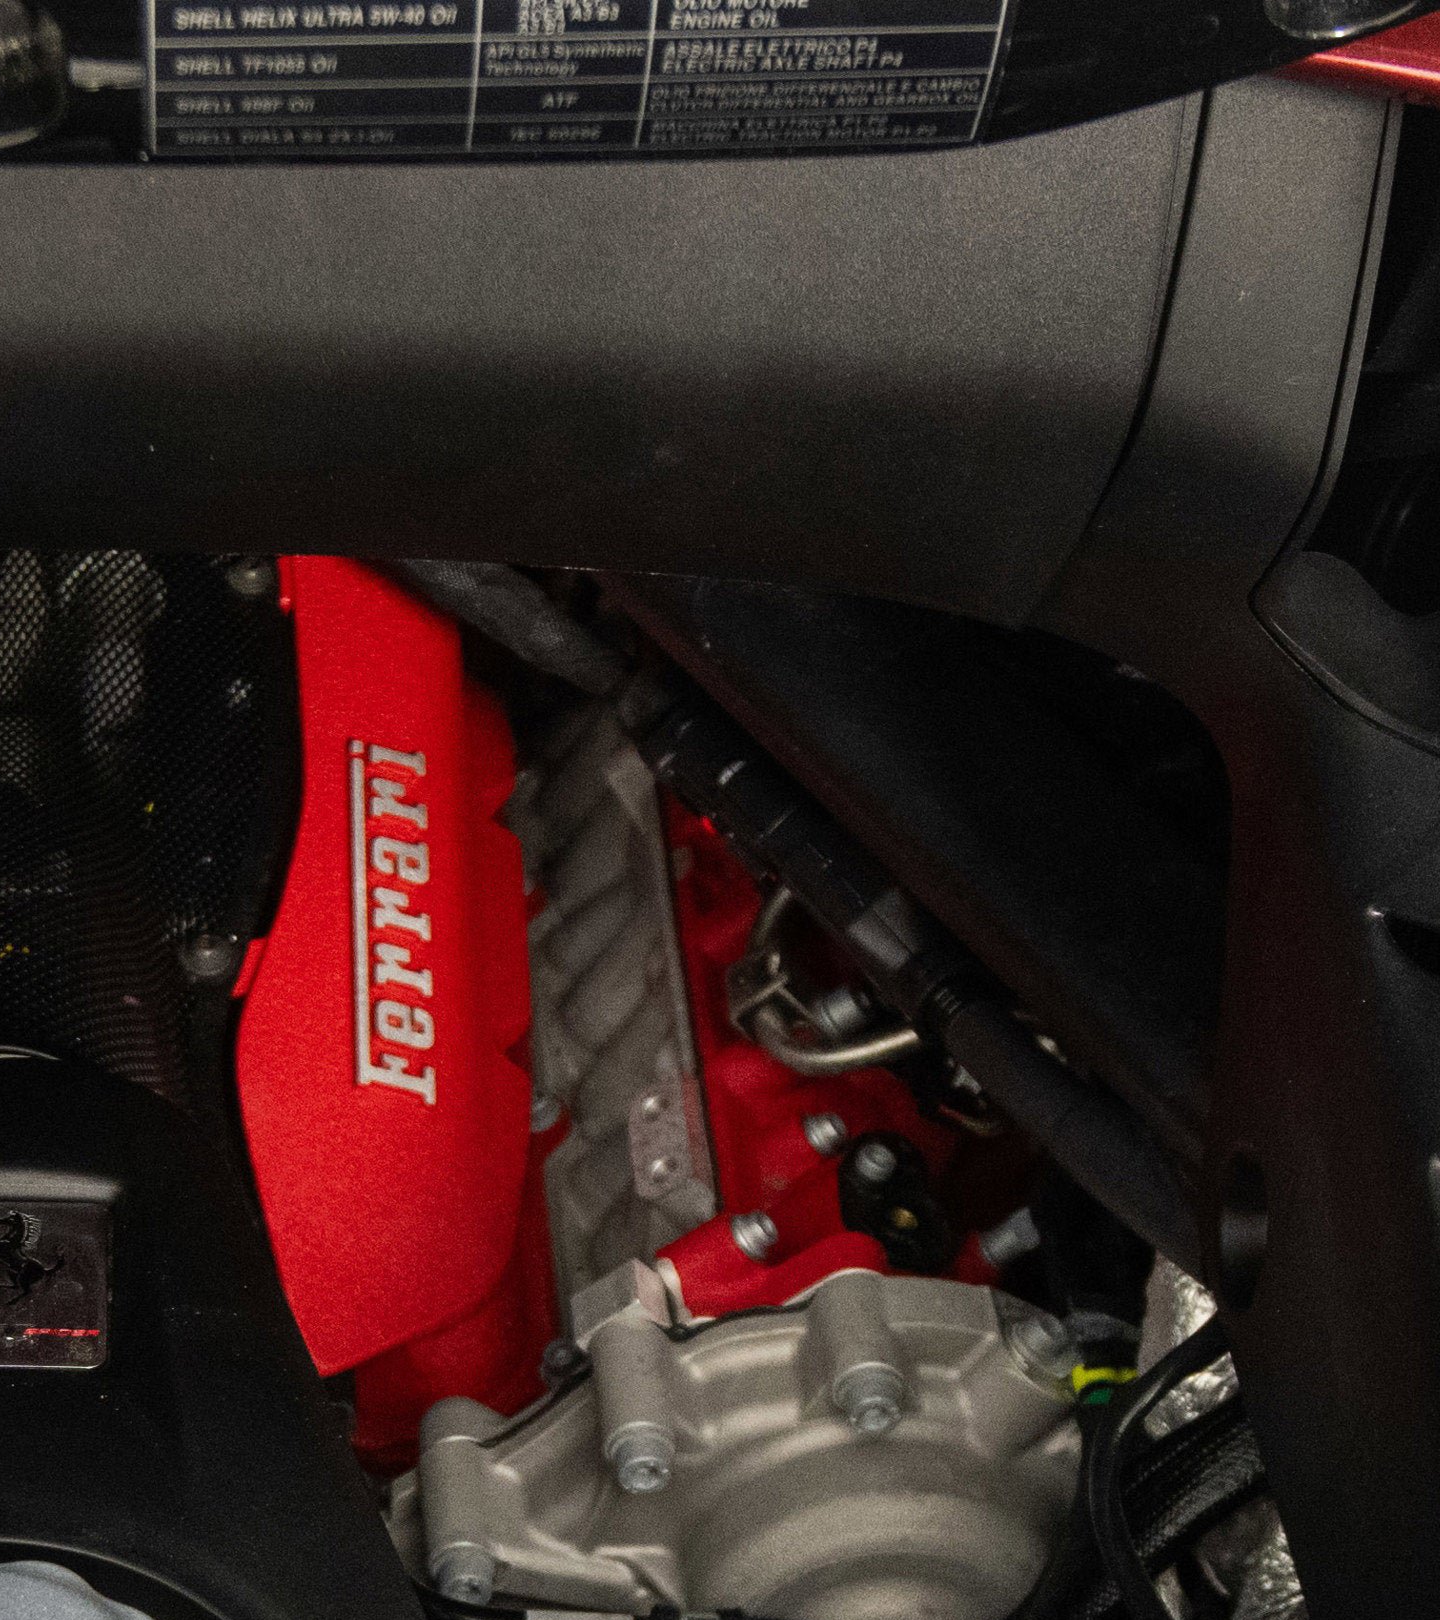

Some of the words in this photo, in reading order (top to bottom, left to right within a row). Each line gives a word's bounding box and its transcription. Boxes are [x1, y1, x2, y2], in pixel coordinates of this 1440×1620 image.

[175, 7, 234, 29] SHELL
[241, 6, 296, 29] HELIX
[302, 5, 363, 28] ULTRA
[670, 12, 744, 30] ENGINE
[749, 10, 780, 29] OIL
[743, 38, 851, 58] ELETTRICO
[175, 54, 234, 75] SHELL
[662, 56, 755, 74] ELECTRIC
[760, 54, 809, 72] AXLE
[814, 53, 875, 71] SHAFT
[347, 738, 437, 1105] Ferrari
